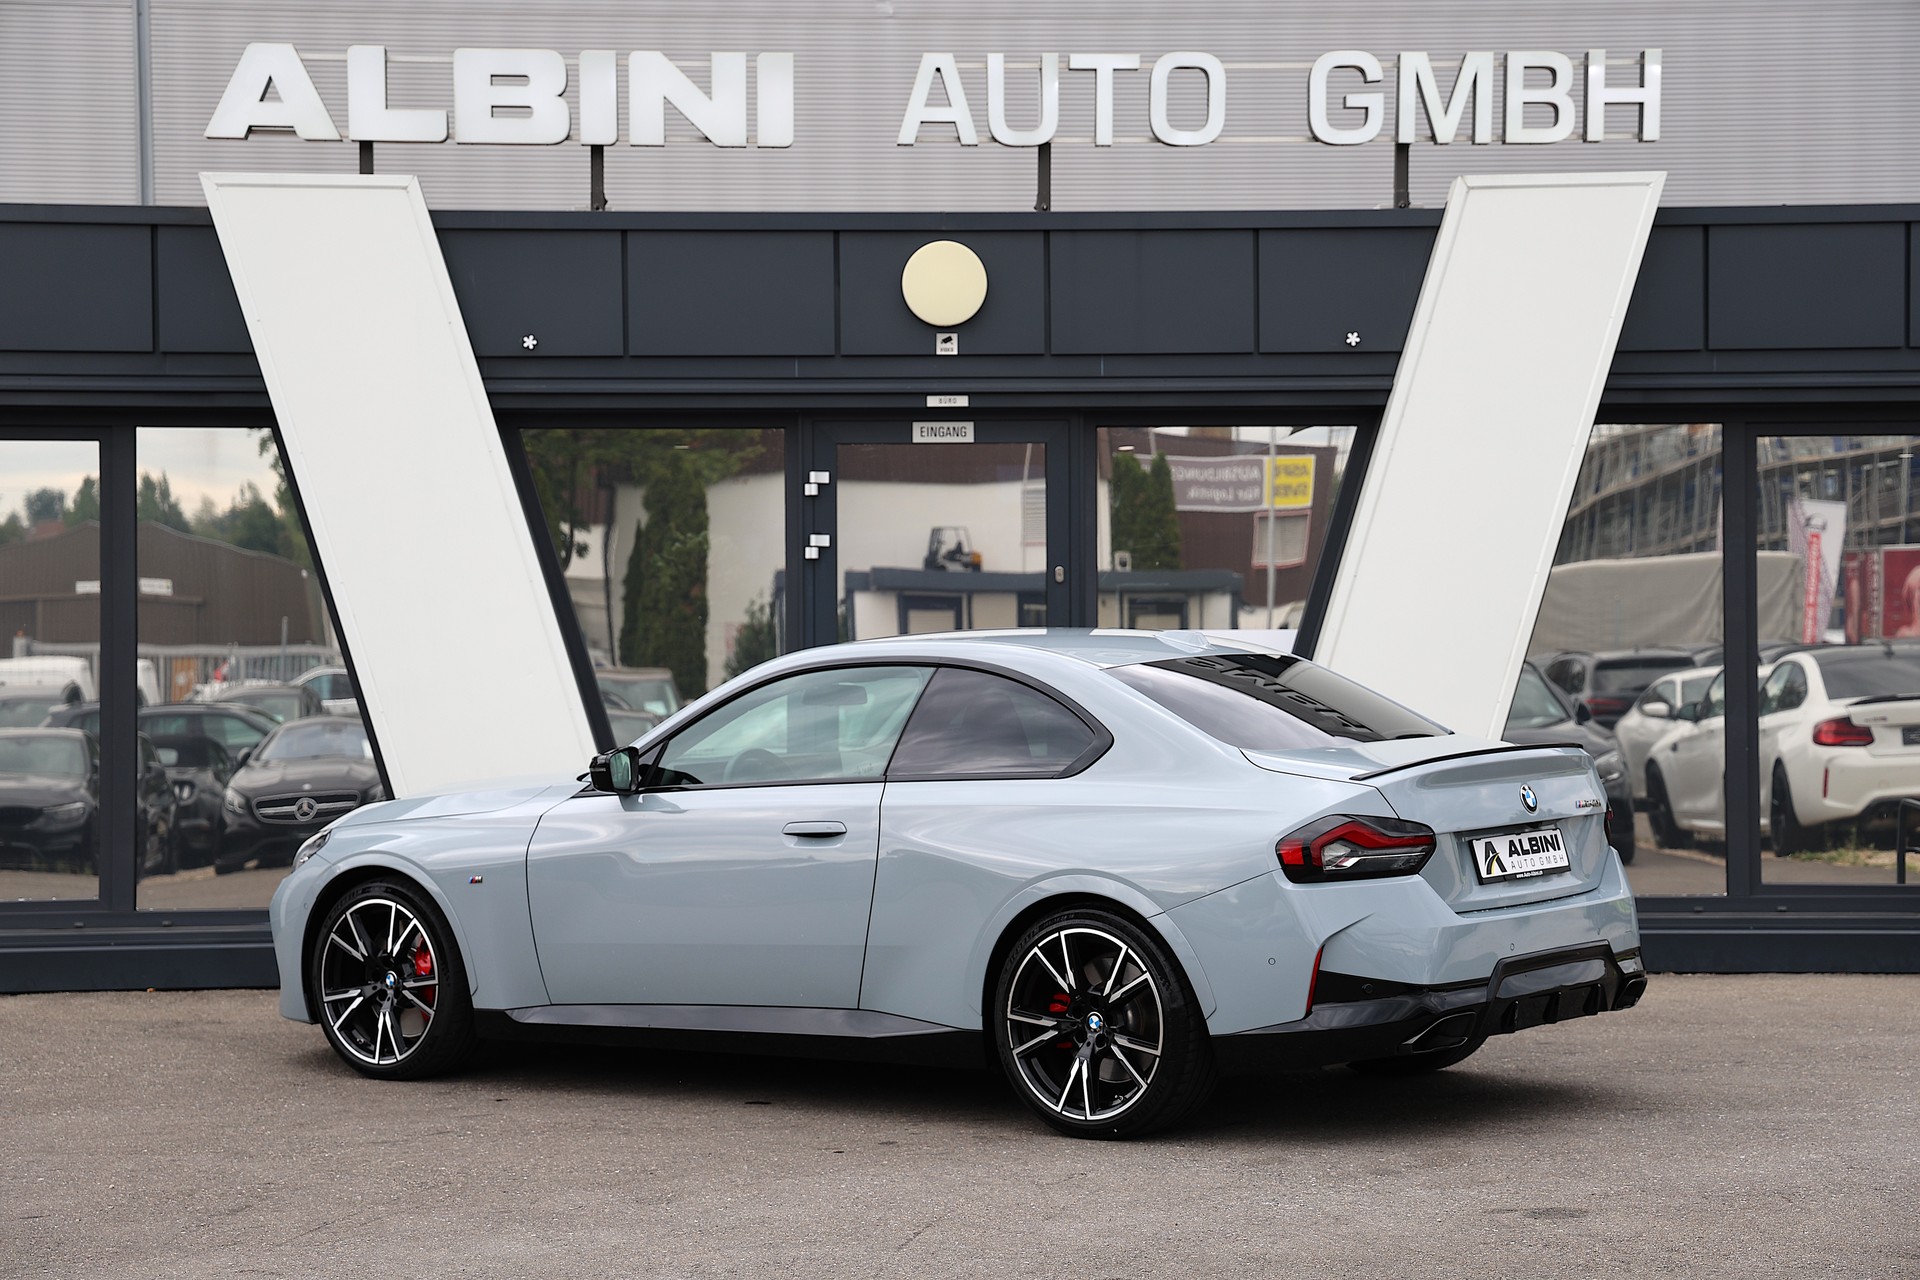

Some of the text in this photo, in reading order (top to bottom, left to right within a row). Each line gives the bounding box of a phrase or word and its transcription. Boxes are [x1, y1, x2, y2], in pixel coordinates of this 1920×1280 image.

[204, 42, 1663, 148] ALBINI AUTO GMBH
[920, 426, 967, 437] EINGANG
[1508, 834, 1561, 857] ALBINI
[1510, 854, 1565, 870] AUTO GMBH
